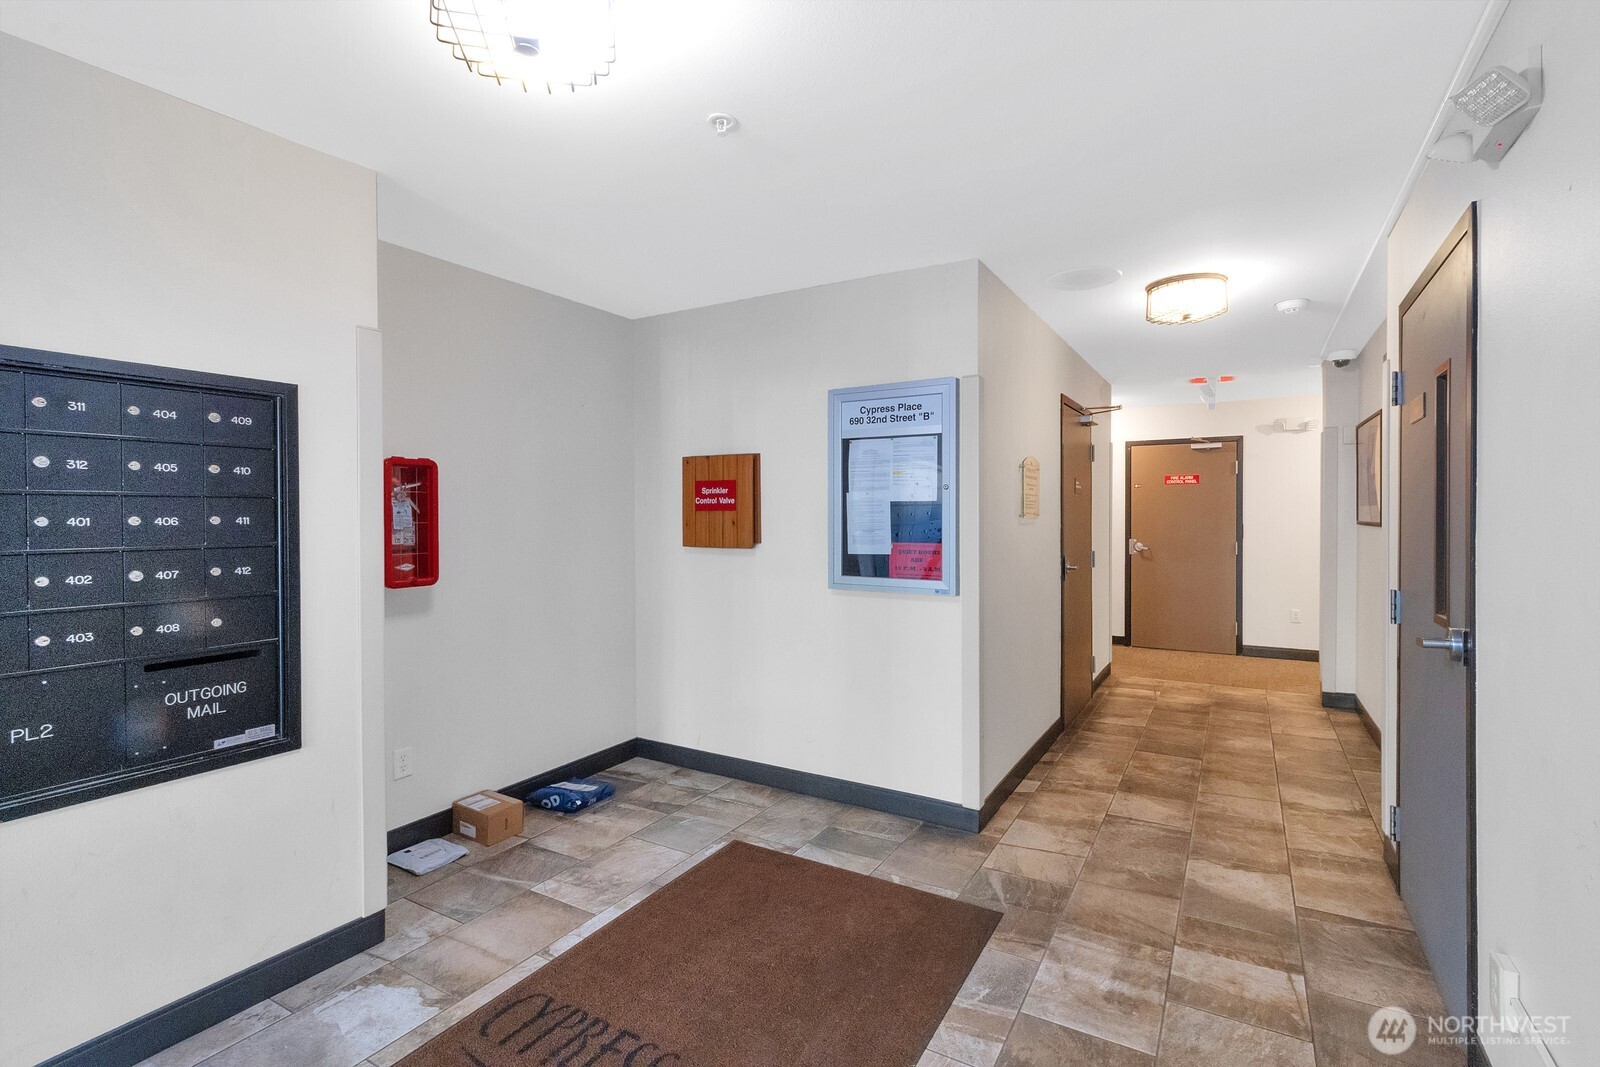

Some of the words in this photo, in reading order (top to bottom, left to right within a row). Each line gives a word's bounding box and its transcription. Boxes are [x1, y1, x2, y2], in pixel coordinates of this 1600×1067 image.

[67, 400, 86, 412] 311
[860, 406, 896, 416] Cypress
[898, 402, 922, 412] Place
[152, 409, 178, 420] 404
[849, 416, 864, 425] 690
[866, 415, 888, 424] 32nd
[890, 413, 916, 422] Street
[918, 412, 934, 420] "B"
[230, 416, 252, 426] 409
[66, 460, 88, 470] 312
[154, 462, 178, 472] 405
[232, 466, 251, 476] 410
[701, 487, 728, 495] Sprinkler
[66, 517, 91, 527] 401
[154, 516, 179, 526] 406
[235, 516, 250, 526] 411
[155, 570, 180, 580] 407
[234, 566, 252, 575] 412
[64, 575, 93, 585] 402
[156, 624, 180, 634] 408
[66, 632, 94, 644] 403
[164, 680, 247, 706] OUTGOING
[186, 702, 226, 720] MAIL
[10, 724, 54, 744] PL2
